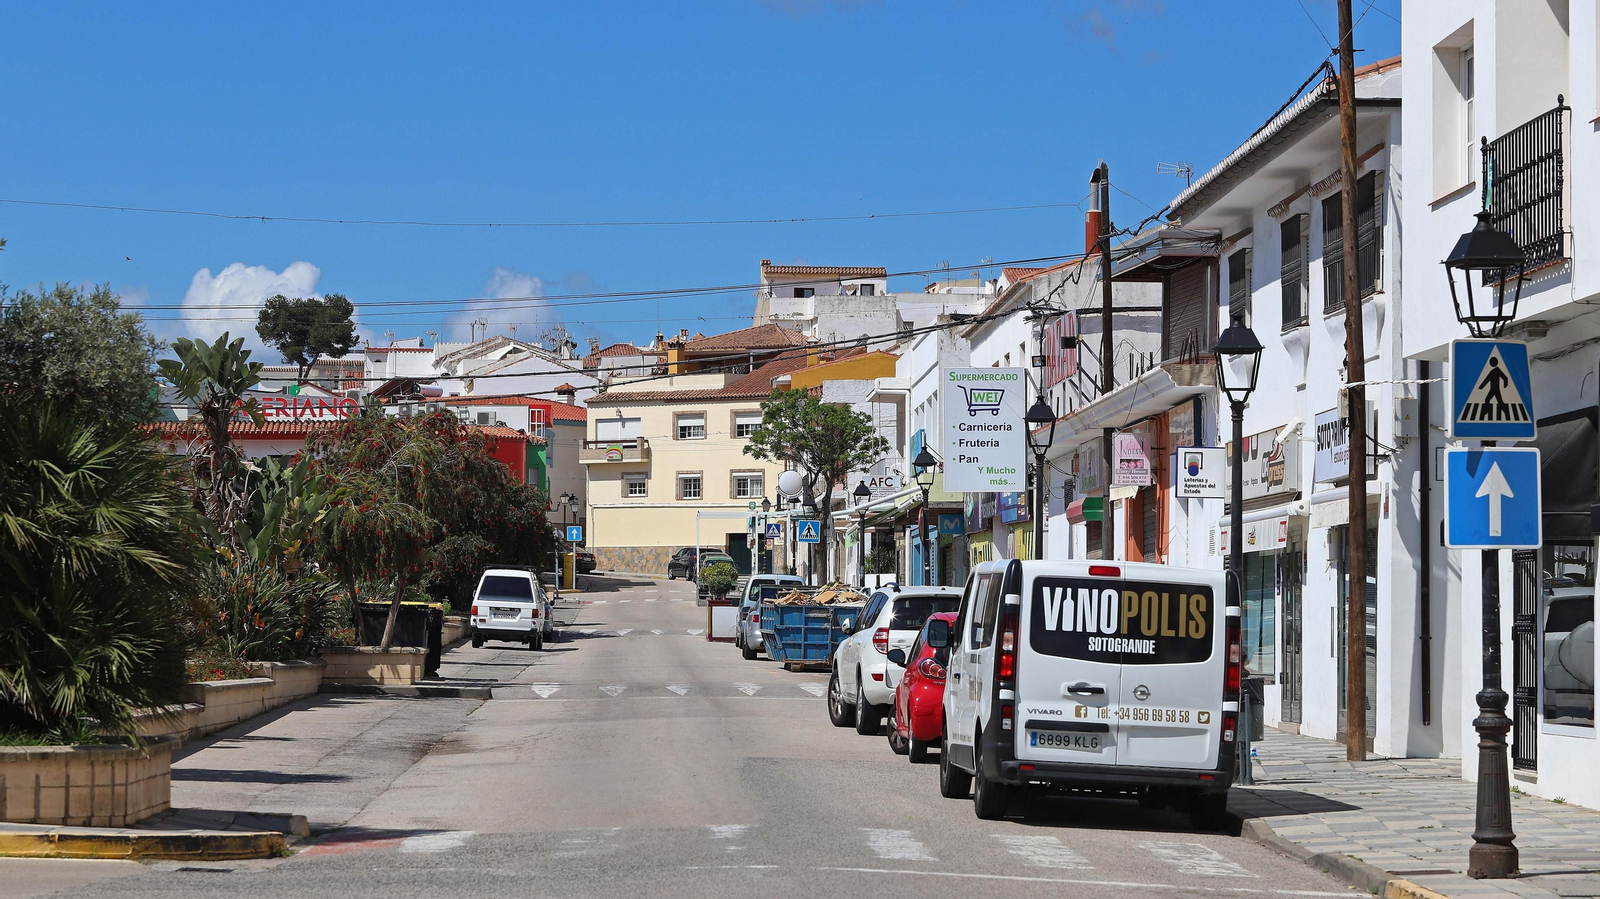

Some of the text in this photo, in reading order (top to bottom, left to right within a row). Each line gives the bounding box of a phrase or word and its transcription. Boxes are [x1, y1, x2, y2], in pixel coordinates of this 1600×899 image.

[949, 371, 1018, 381] SUPERMERCADO
[973, 392, 999, 403] WEI
[958, 422, 1012, 431] Carnicería
[958, 438, 1000, 448] Frutería
[958, 455, 979, 463] Pan
[869, 477, 893, 487] AFC
[1088, 637, 1156, 654] SOTOGRANDE
[1027, 708, 1063, 716] VIVARO
[1097, 706, 1190, 723] Tel: +34 956 69 58 58
[1039, 733, 1098, 749] 6899 KLG
